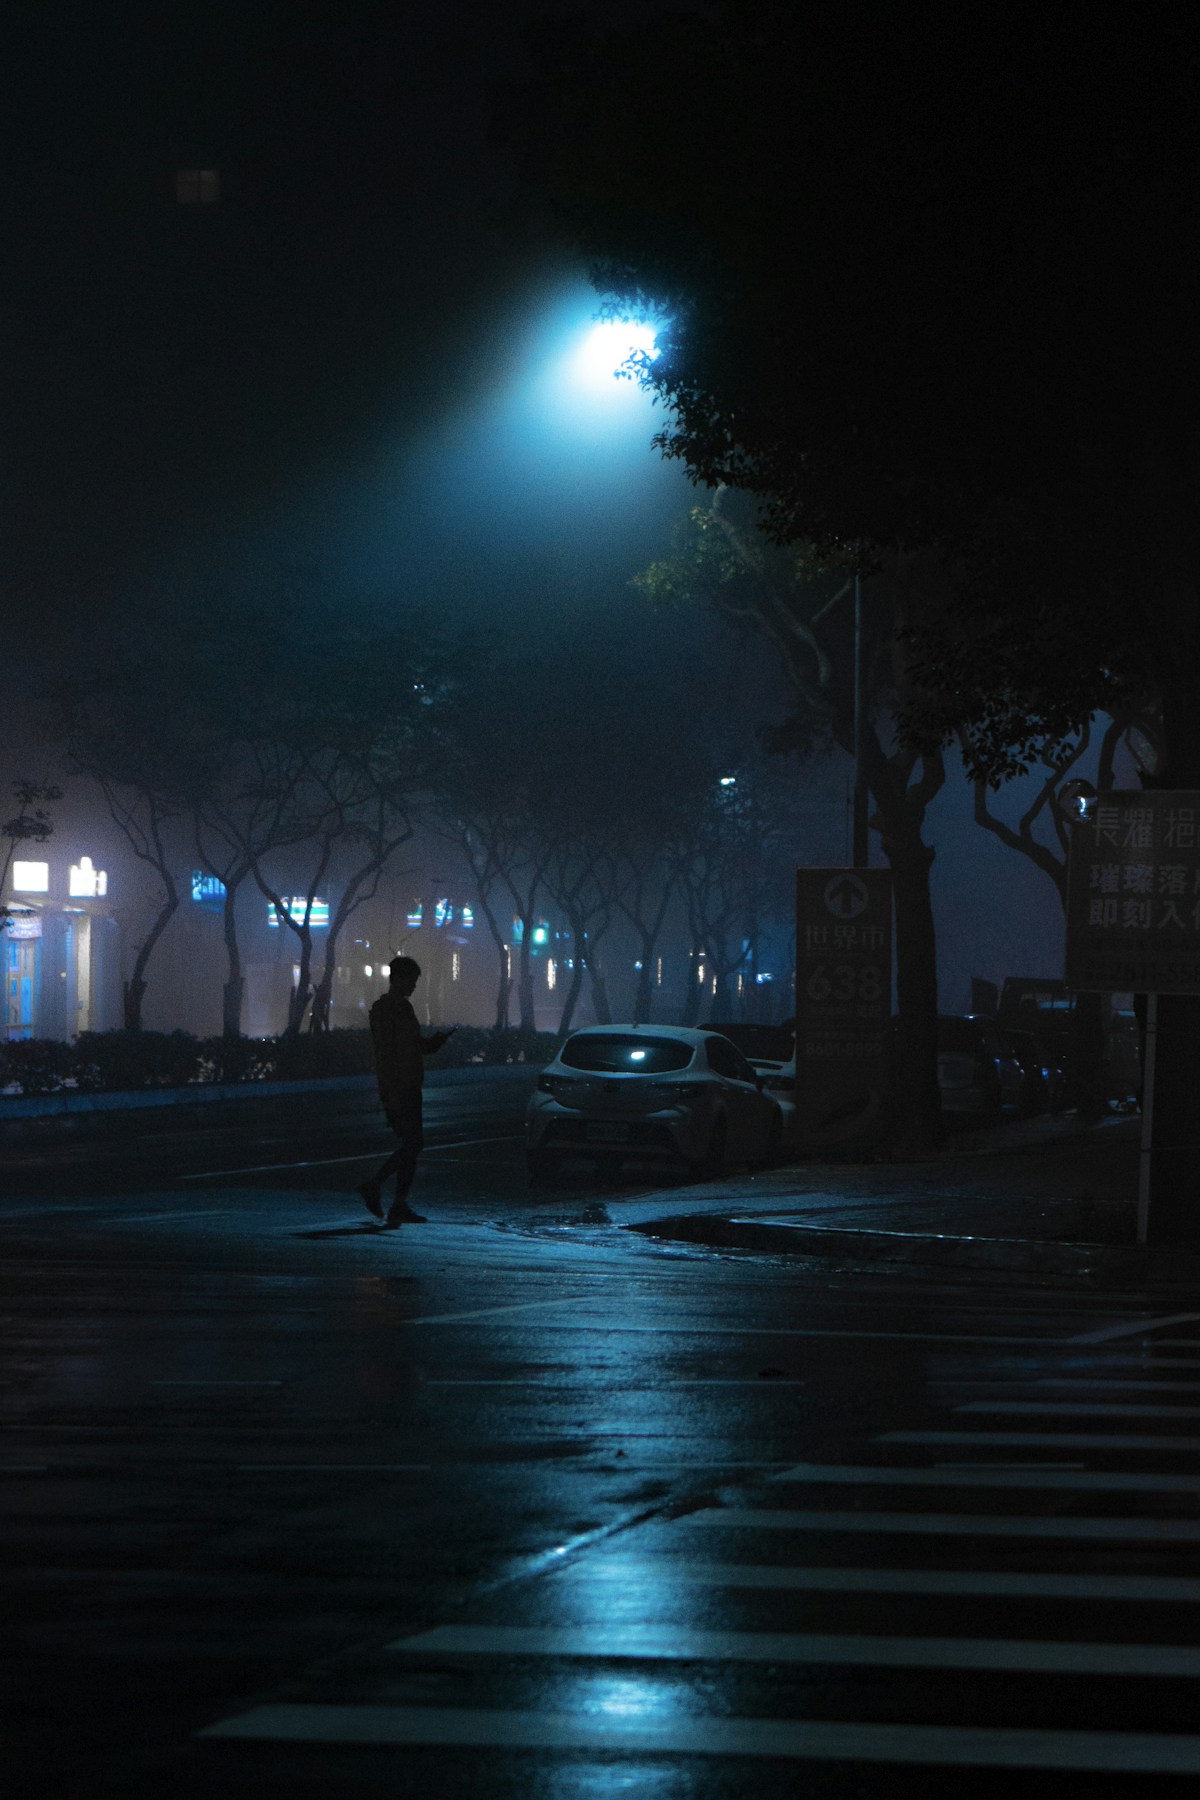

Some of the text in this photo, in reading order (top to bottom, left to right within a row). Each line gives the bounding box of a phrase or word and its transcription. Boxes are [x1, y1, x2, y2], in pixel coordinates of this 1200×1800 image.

[1092, 807, 1200, 848] 長耀挹
[1089, 863, 1200, 895] 璀璨落
[804, 924, 886, 951] 世界市
[806, 965, 882, 1001] 638
